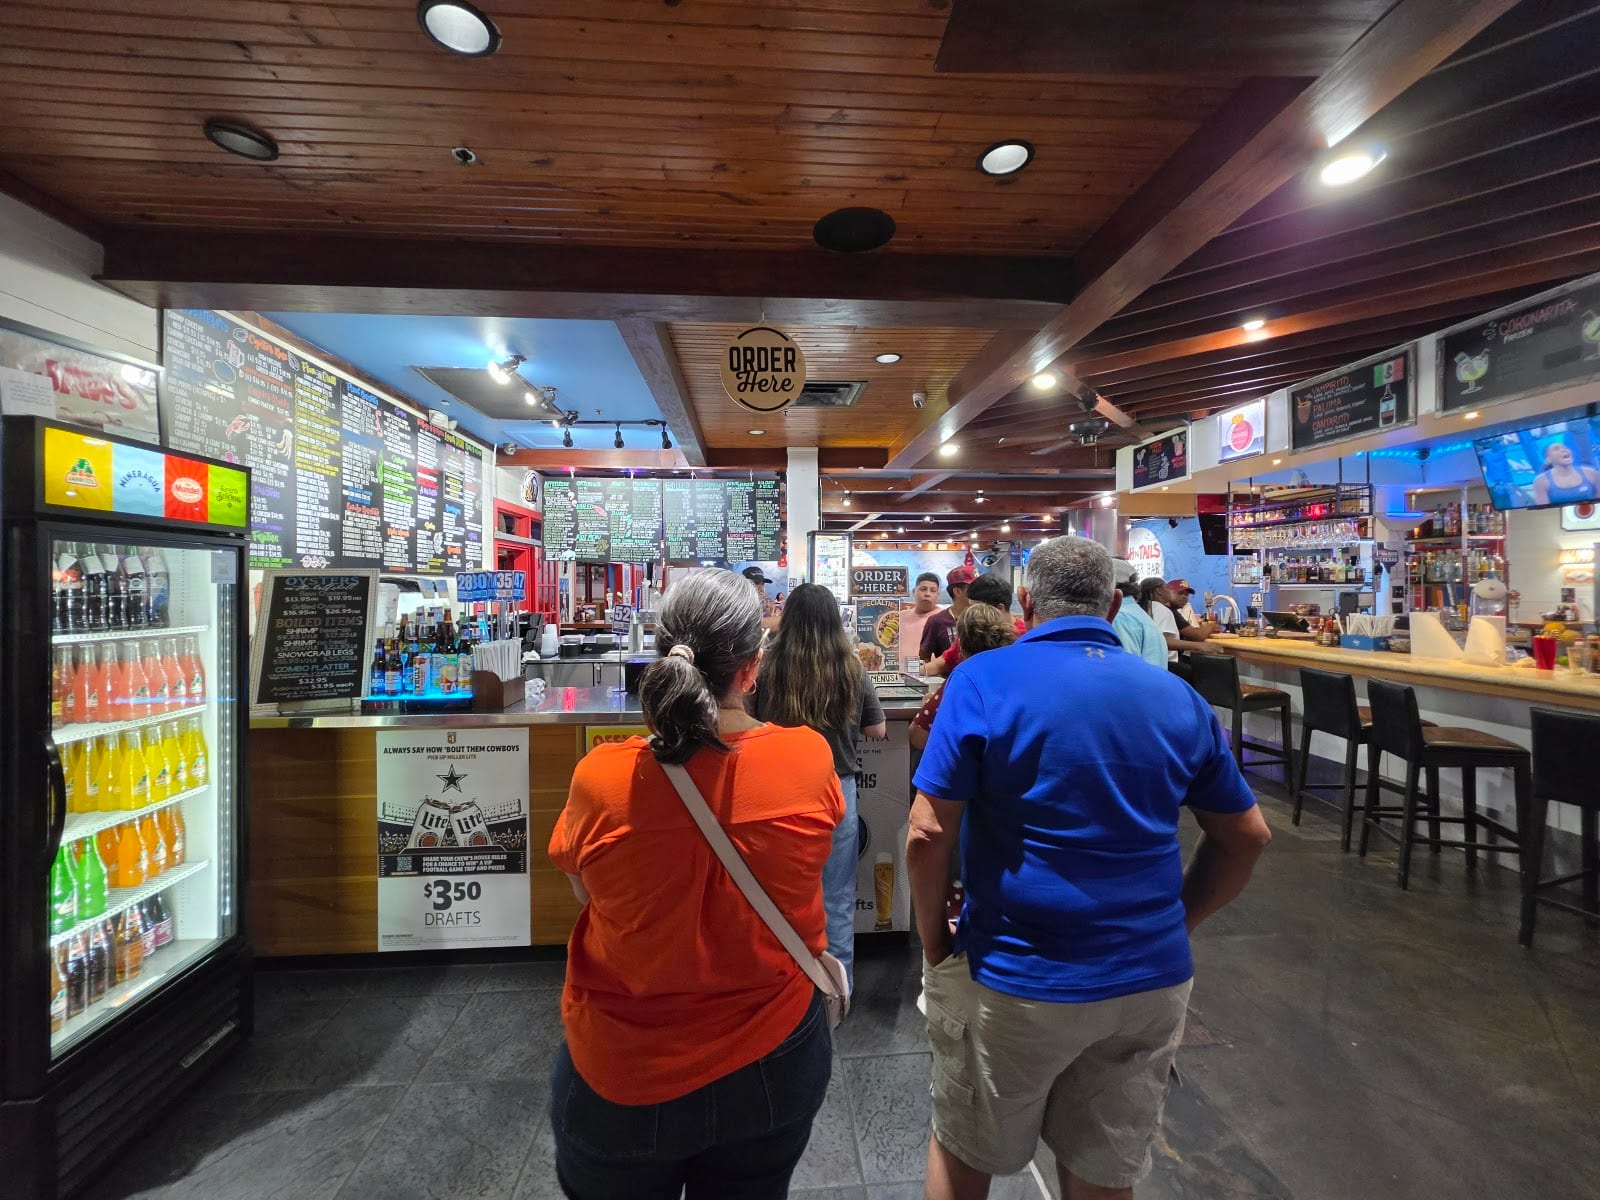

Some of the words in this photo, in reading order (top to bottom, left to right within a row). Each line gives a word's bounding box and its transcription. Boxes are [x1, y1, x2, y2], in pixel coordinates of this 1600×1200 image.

[1499, 297, 1577, 336] CORONARITA
[1503, 327, 1533, 345] FROZEN
[729, 346, 796, 372] ORDER
[736, 370, 794, 392] Here
[119, 470, 160, 492] MINERAGUA
[285, 577, 360, 586] OYSTERS
[458, 574, 472, 590] 28
[496, 572, 512, 588] 35
[514, 572, 525, 588] 47
[854, 570, 902, 582] ORDER
[864, 583, 893, 592] HERE
[276, 617, 321, 628] BOILED
[325, 616, 363, 626] ITEMS
[614, 606, 630, 622] 52
[275, 665, 310, 673] COMBO
[311, 663, 350, 671] PLATTER
[870, 674, 896, 682] MENUS
[420, 811, 448, 830] Lite
[456, 812, 482, 834] Lite
[425, 911, 481, 926] DRAFTS
